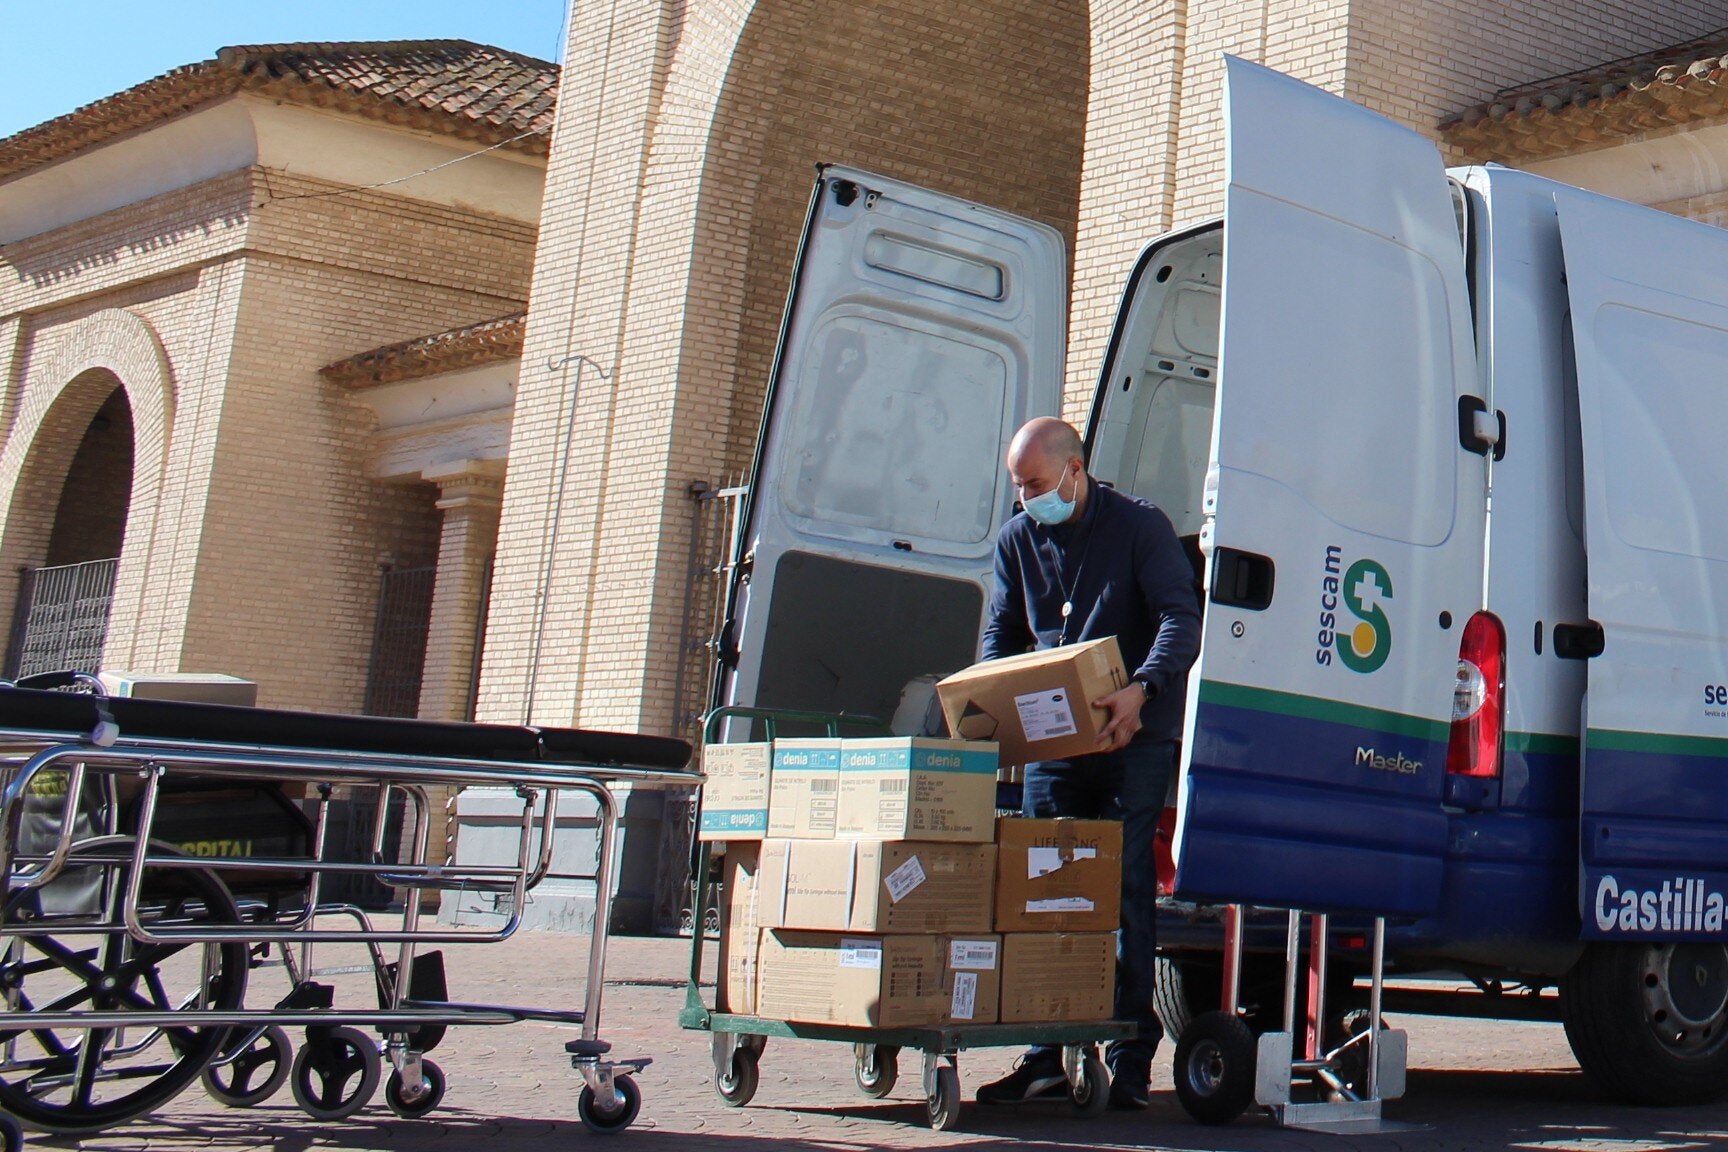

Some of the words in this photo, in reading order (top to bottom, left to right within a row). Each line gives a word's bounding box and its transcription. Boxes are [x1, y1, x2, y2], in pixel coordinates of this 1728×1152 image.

[1316, 545, 1341, 666] sescam
[783, 752, 808, 766] denia
[850, 752, 876, 766] denia
[927, 752, 961, 768] denia
[1355, 746, 1423, 774] Master
[1034, 836, 1098, 848] LIFEONG
